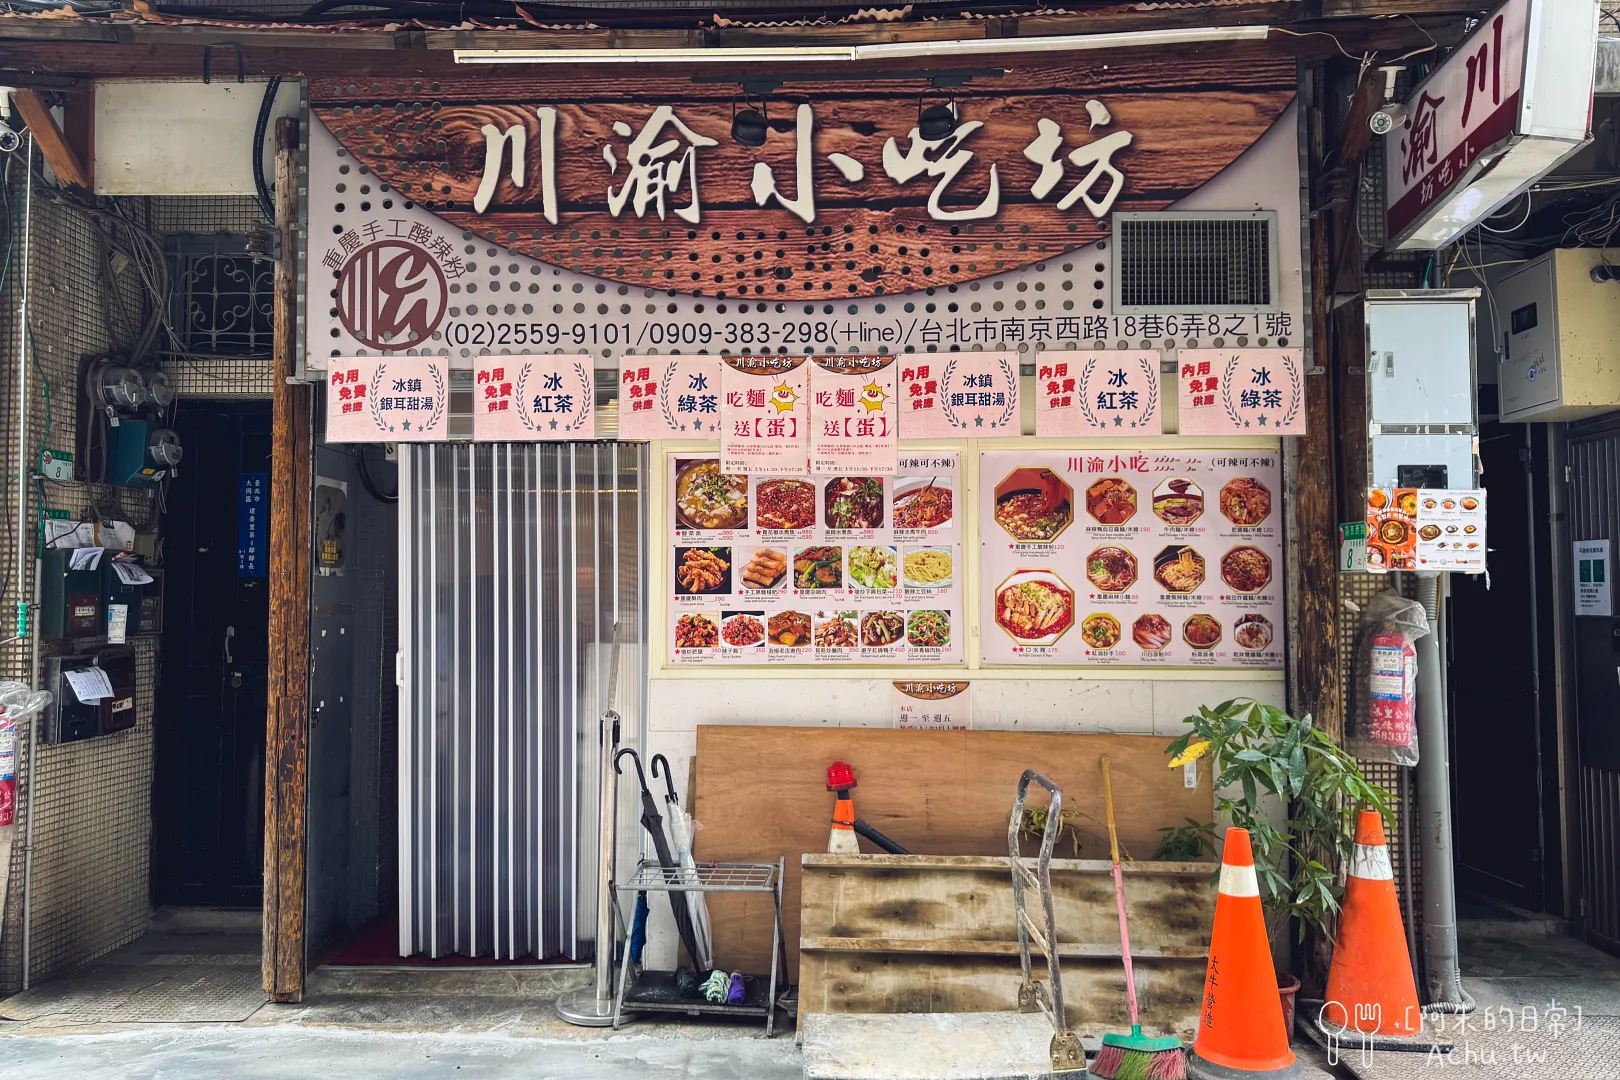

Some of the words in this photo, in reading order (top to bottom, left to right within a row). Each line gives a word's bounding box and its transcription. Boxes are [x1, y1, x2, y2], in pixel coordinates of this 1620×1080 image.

[473, 99, 1134, 225] 川渝小吃坊
[322, 219, 466, 280] 重慶手工酸辣粉
[736, 356, 793, 368] 川渝小吃坊
[825, 356, 882, 368] 川渝小吃坊
[1181, 361, 1211, 378] 內用
[332, 367, 359, 385] 內用
[477, 367, 505, 384] 內用
[622, 367, 650, 383] 內用
[902, 365, 930, 382] 內用
[1039, 363, 1068, 380] 內用
[1107, 368, 1128, 388] 冰
[1251, 366, 1272, 386] 冰
[392, 378, 422, 393] 冰鎮
[543, 372, 563, 391] 冰
[688, 372, 708, 392] 冰
[909, 380, 938, 397] 免費
[963, 374, 993, 388] 冰鎮
[1046, 378, 1076, 395] 免費
[1189, 377, 1219, 394] 免費
[339, 384, 367, 401] 免費
[484, 383, 513, 399] 免費
[629, 382, 658, 399] 免費
[726, 388, 766, 408] 吃麵
[816, 388, 855, 408] 吃麵
[1240, 389, 1282, 409] 綠茶
[341, 401, 363, 414] 供應
[380, 397, 434, 411] 銀耳甜湯
[488, 400, 509, 412] 供應
[533, 394, 573, 414] 紅茶
[632, 400, 653, 412] 供應
[677, 394, 718, 414] 綠茶
[912, 398, 934, 410] 供應
[950, 392, 1006, 407] 銀耳甜湯
[1049, 396, 1072, 409] 供應
[1097, 391, 1139, 410] 紅茶
[1192, 394, 1215, 407] 供應
[733, 417, 797, 438] 送【蛋】
[823, 417, 887, 438] 送【蛋】
[1066, 454, 1150, 473] 川渝小吃
[1211, 457, 1275, 468] (可辣可不辣)
[55, 466, 62, 478] 8
